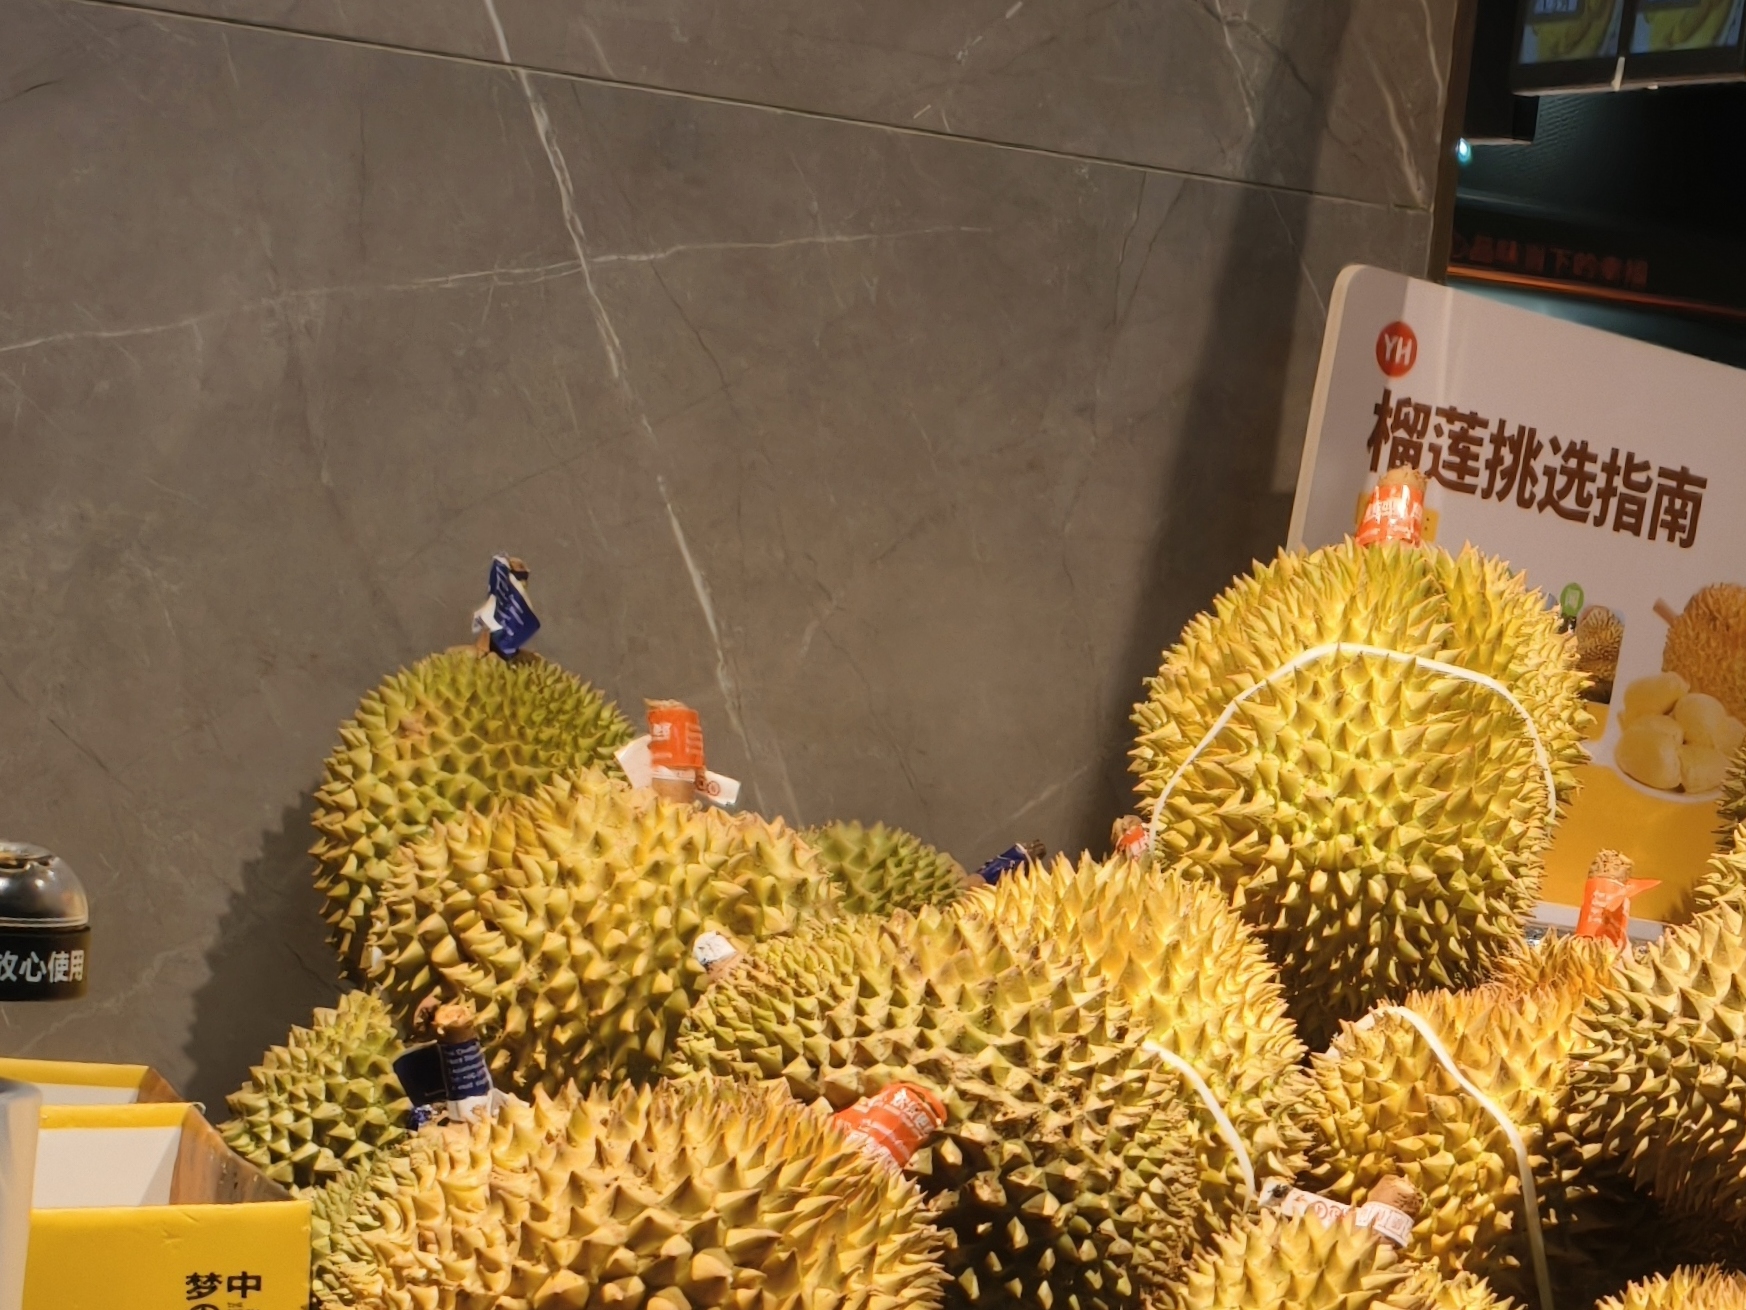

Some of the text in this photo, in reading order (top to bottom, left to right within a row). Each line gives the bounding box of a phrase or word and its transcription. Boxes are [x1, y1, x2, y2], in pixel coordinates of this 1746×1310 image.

[1383, 333, 1413, 366] YH
[1367, 386, 1709, 549] 榴莲挑选指南
[185, 1271, 262, 1300] 梦中
